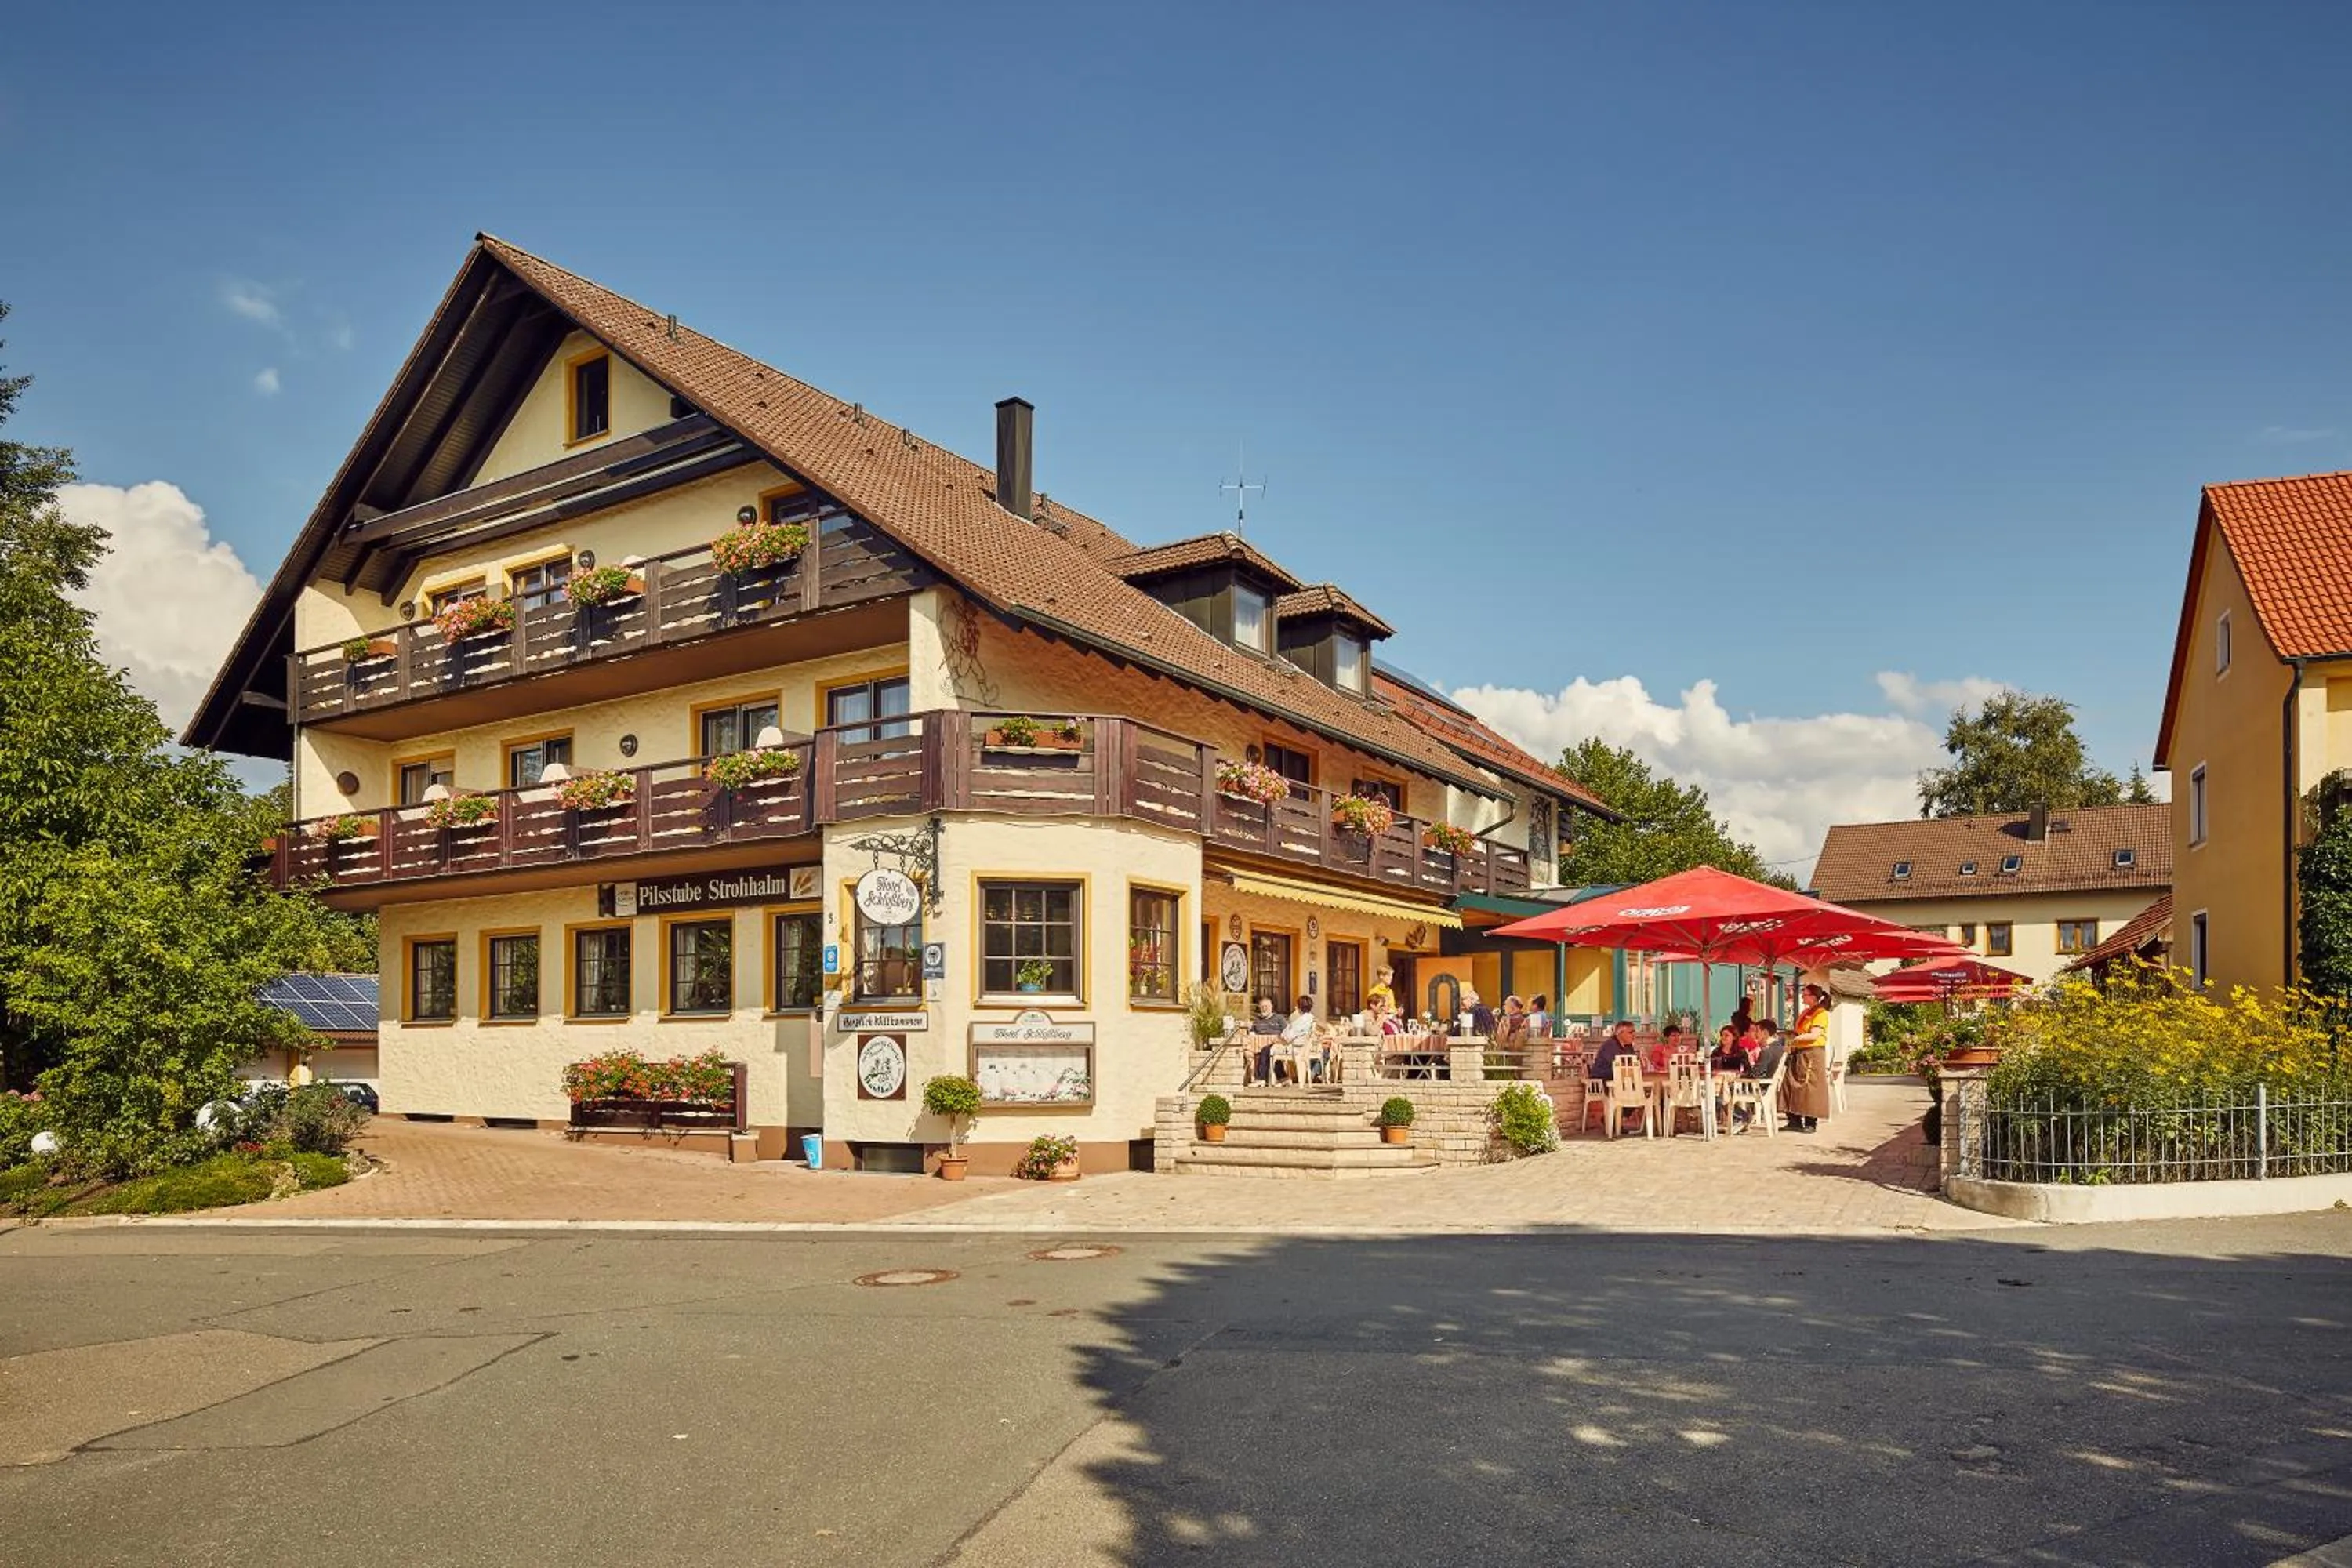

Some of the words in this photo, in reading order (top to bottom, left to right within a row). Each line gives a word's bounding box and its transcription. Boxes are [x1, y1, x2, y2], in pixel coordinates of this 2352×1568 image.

[639, 882, 702, 906] Pilsstube
[708, 875, 786, 901] Strohhalm
[877, 876, 903, 893] Hotel
